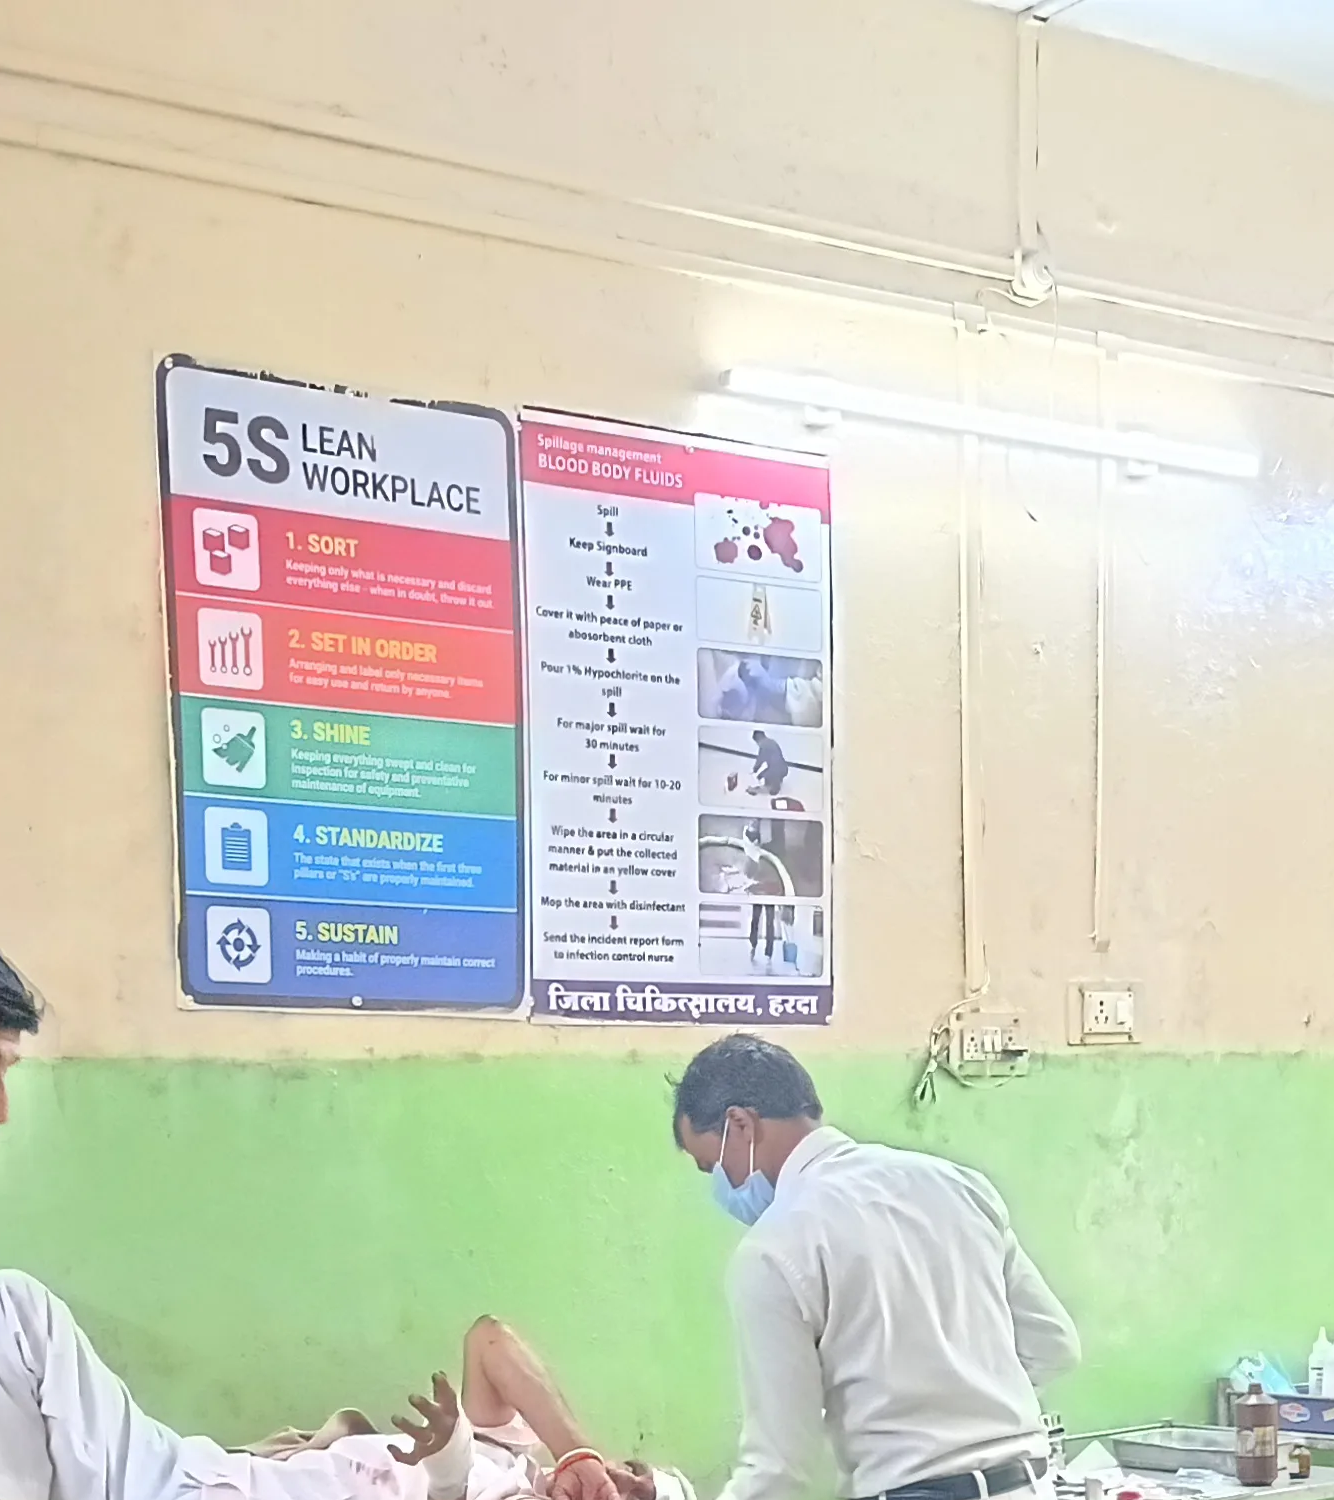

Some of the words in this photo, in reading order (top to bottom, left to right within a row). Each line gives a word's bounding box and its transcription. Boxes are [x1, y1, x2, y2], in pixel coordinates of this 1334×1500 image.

[203, 407, 290, 484] 5S
[301, 423, 377, 462] LEAN
[537, 433, 584, 455] Spillage
[587, 442, 662, 465] management
[538, 453, 588, 475] BLOOD
[591, 460, 630, 481] BODY
[634, 467, 683, 489] FLUIDS
[303, 462, 482, 515] WORKPLACE
[597, 504, 619, 517] Spill
[287, 532, 302, 551] 1.
[307, 534, 358, 558] SORT
[569, 537, 594, 552] Keep
[597, 540, 648, 558] Signboard
[286, 560, 326, 576] Keeping
[329, 567, 349, 579] only
[286, 578, 338, 593] everything
[586, 576, 611, 589] Wear
[614, 579, 632, 591] PPE
[536, 607, 564, 620] Cover
[566, 611, 573, 621] it
[576, 613, 598, 623] with
[600, 617, 628, 628] peace
[631, 617, 641, 628] of
[643, 621, 671, 633] paper
[288, 629, 305, 649] 2.
[311, 632, 348, 654] SET
[352, 636, 370, 657] IN
[376, 638, 437, 664] ORDER
[628, 636, 652, 646] cloth
[541, 662, 564, 673] Pour
[567, 664, 582, 675] 1%
[584, 666, 648, 681] Hypochlorite
[602, 686, 622, 699] spill
[290, 720, 308, 740] 3.
[313, 722, 371, 746] SHINE
[557, 719, 573, 730] For
[575, 722, 605, 735] major
[607, 723, 627, 736] spill
[629, 725, 650, 735] wait
[652, 725, 666, 736] for
[585, 739, 598, 749] 30
[599, 741, 639, 752] minutes
[291, 750, 331, 765] Keeping
[333, 755, 383, 769] everything
[543, 771, 559, 782] For
[561, 773, 590, 784] minor
[592, 775, 613, 788] spill
[615, 777, 636, 787] wait
[638, 777, 652, 788] for
[654, 779, 681, 790] 10-20
[593, 794, 632, 804] minutes
[294, 825, 311, 844] 4.
[315, 826, 444, 853] STANDARDIZE
[551, 826, 575, 840] Wipe
[578, 828, 594, 838] the
[620, 830, 628, 840] in
[548, 846, 585, 855] manner
[587, 846, 595, 855] &
[597, 848, 614, 860] put
[616, 847, 632, 857] the
[634, 848, 677, 860] collected
[549, 864, 589, 873] material
[618, 865, 648, 878] yellow
[651, 869, 676, 877] cover
[541, 897, 562, 911] Mop
[564, 898, 581, 908] the
[583, 901, 603, 909] area
[606, 900, 627, 910] with
[629, 900, 685, 912] disinfectant
[295, 921, 312, 941] 5.
[317, 923, 398, 945] SUSTAIN
[543, 933, 568, 943] Send
[570, 933, 585, 943] the
[587, 934, 627, 945] incident
[629, 937, 659, 949] report
[661, 936, 684, 946] form
[296, 951, 332, 965] Making
[368, 953, 378, 963] of
[554, 951, 564, 959] to
[566, 950, 610, 961] infection
[612, 952, 645, 962] control
[548, 983, 610, 1012] जिला
[617, 984, 763, 1020] चिकित्सालय,
[768, 995, 818, 1015] हरदा
